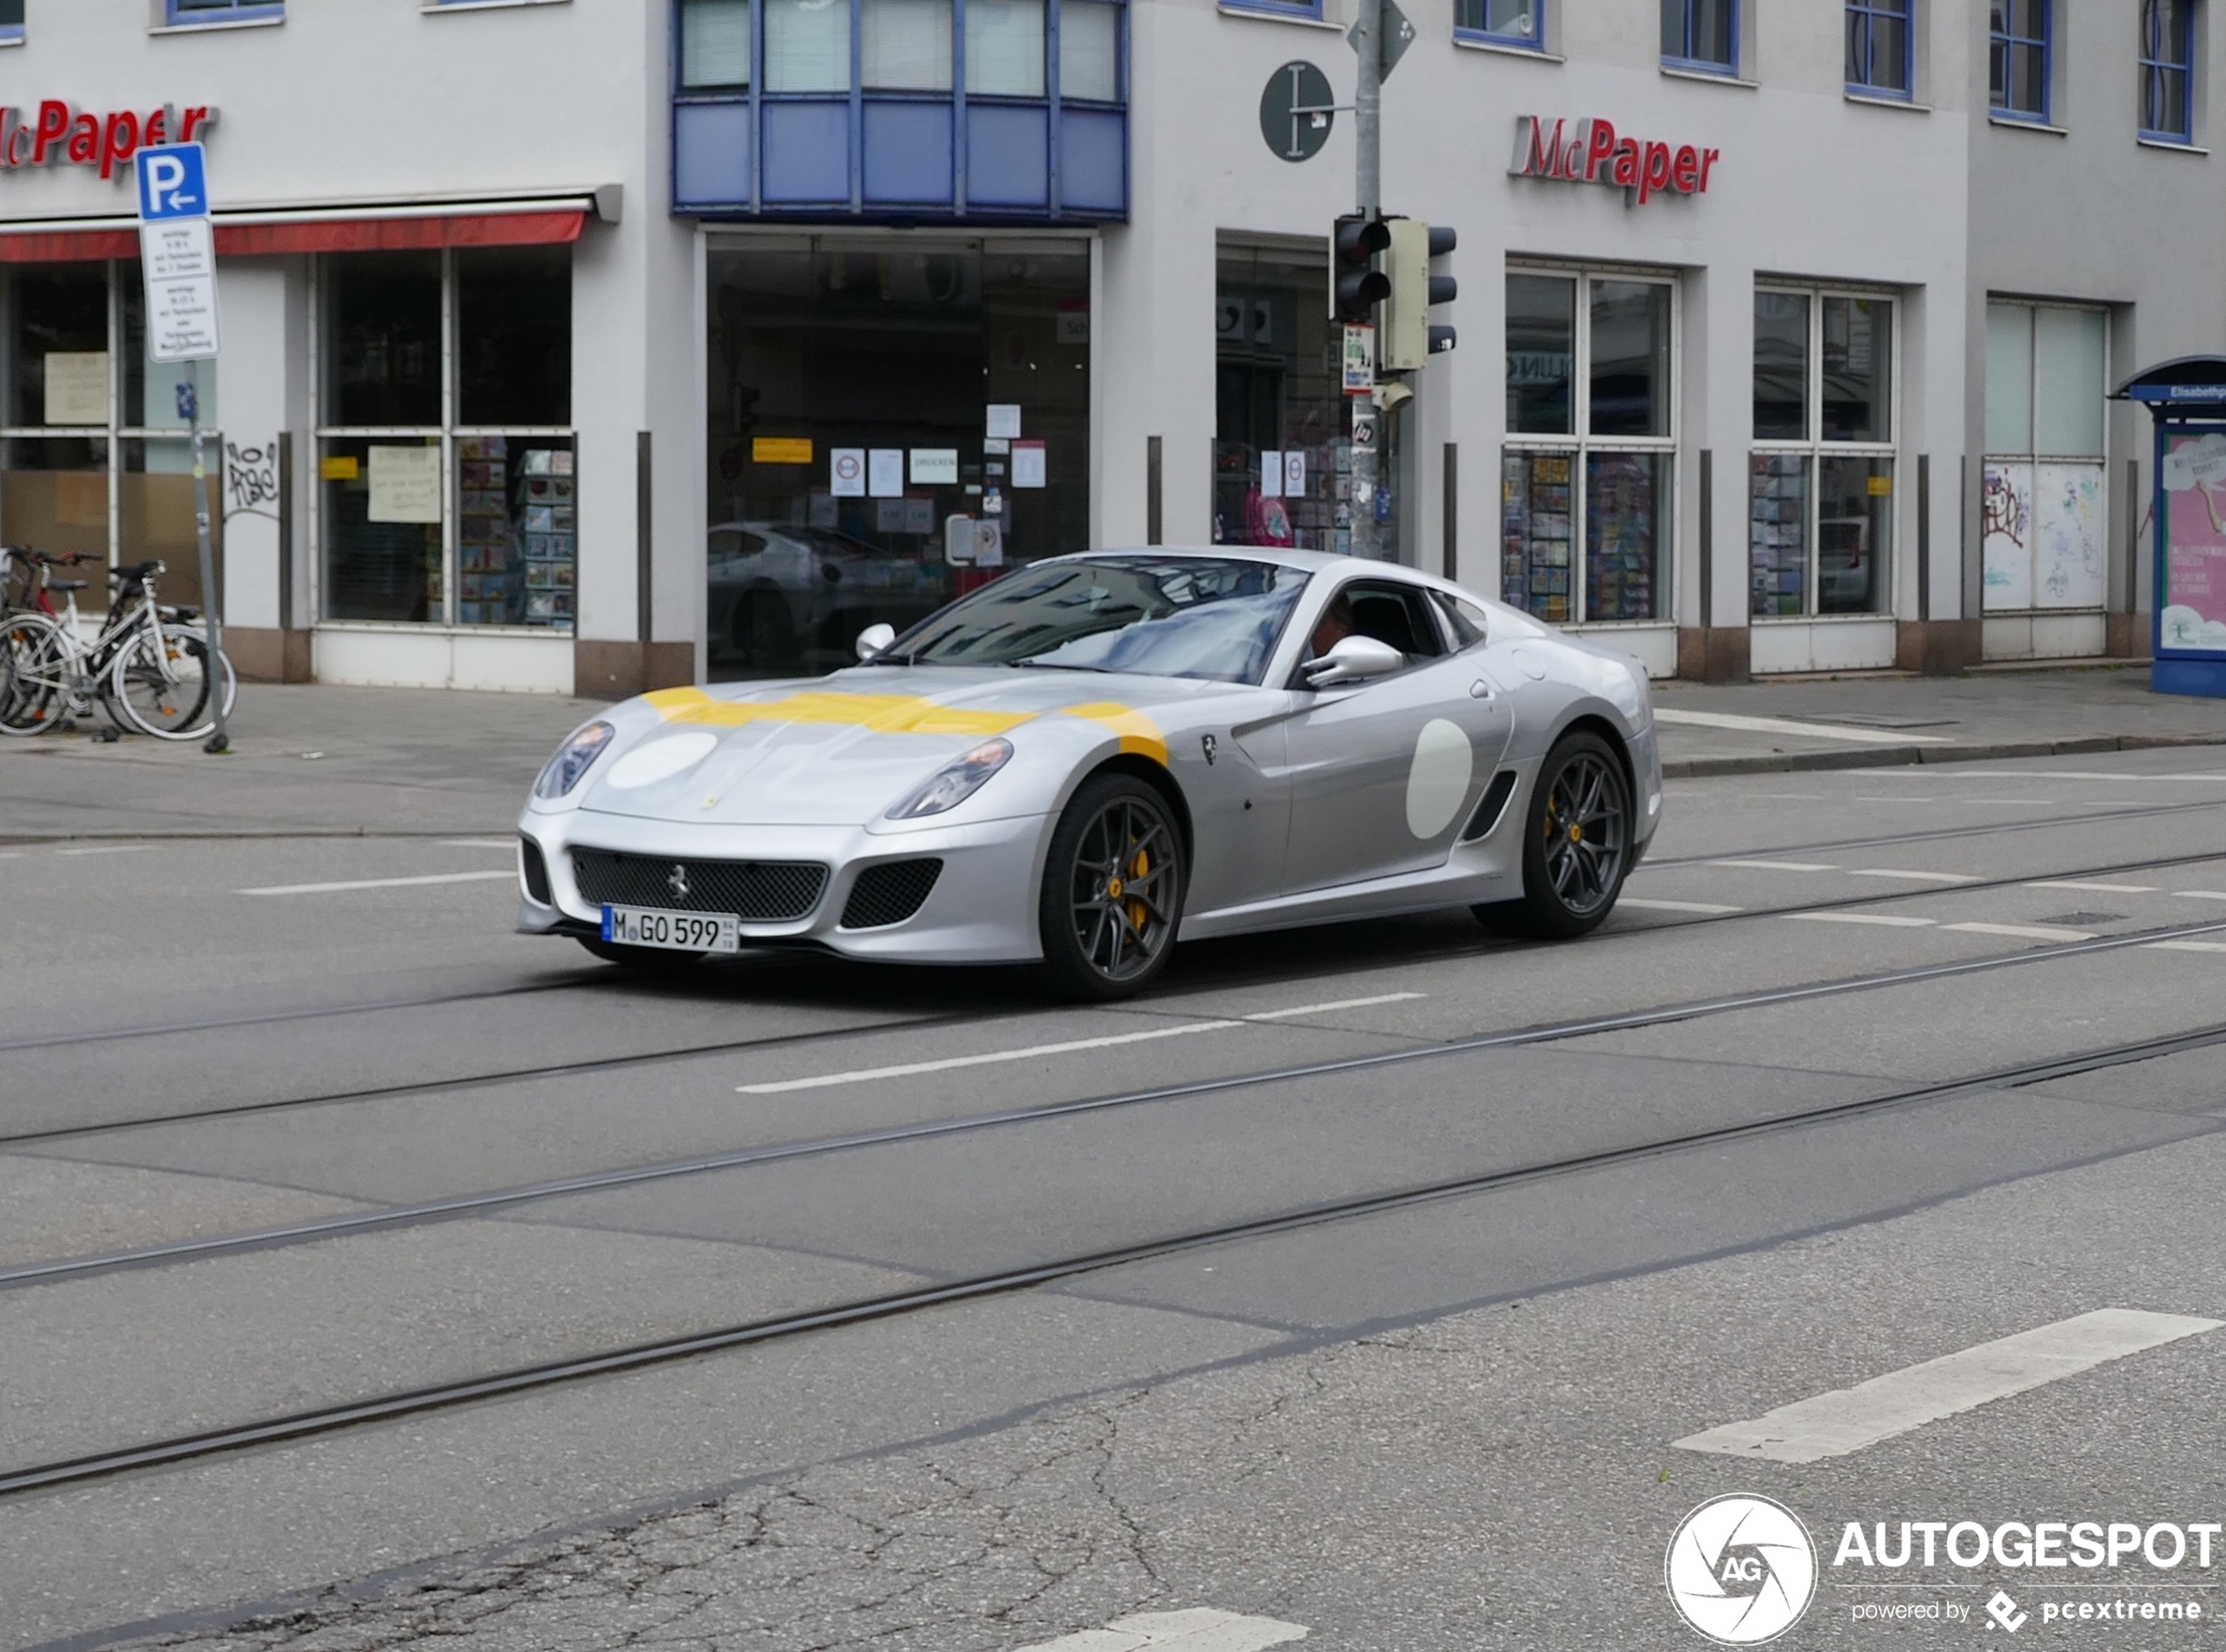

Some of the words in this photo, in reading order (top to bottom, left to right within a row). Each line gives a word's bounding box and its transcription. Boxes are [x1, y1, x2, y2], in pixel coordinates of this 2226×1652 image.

[0, 99, 209, 180] cPaper
[1521, 115, 1719, 205] McPaper
[146, 154, 185, 212] P
[614, 912, 627, 939] M
[641, 915, 669, 943] GO
[675, 918, 720, 947] 599
